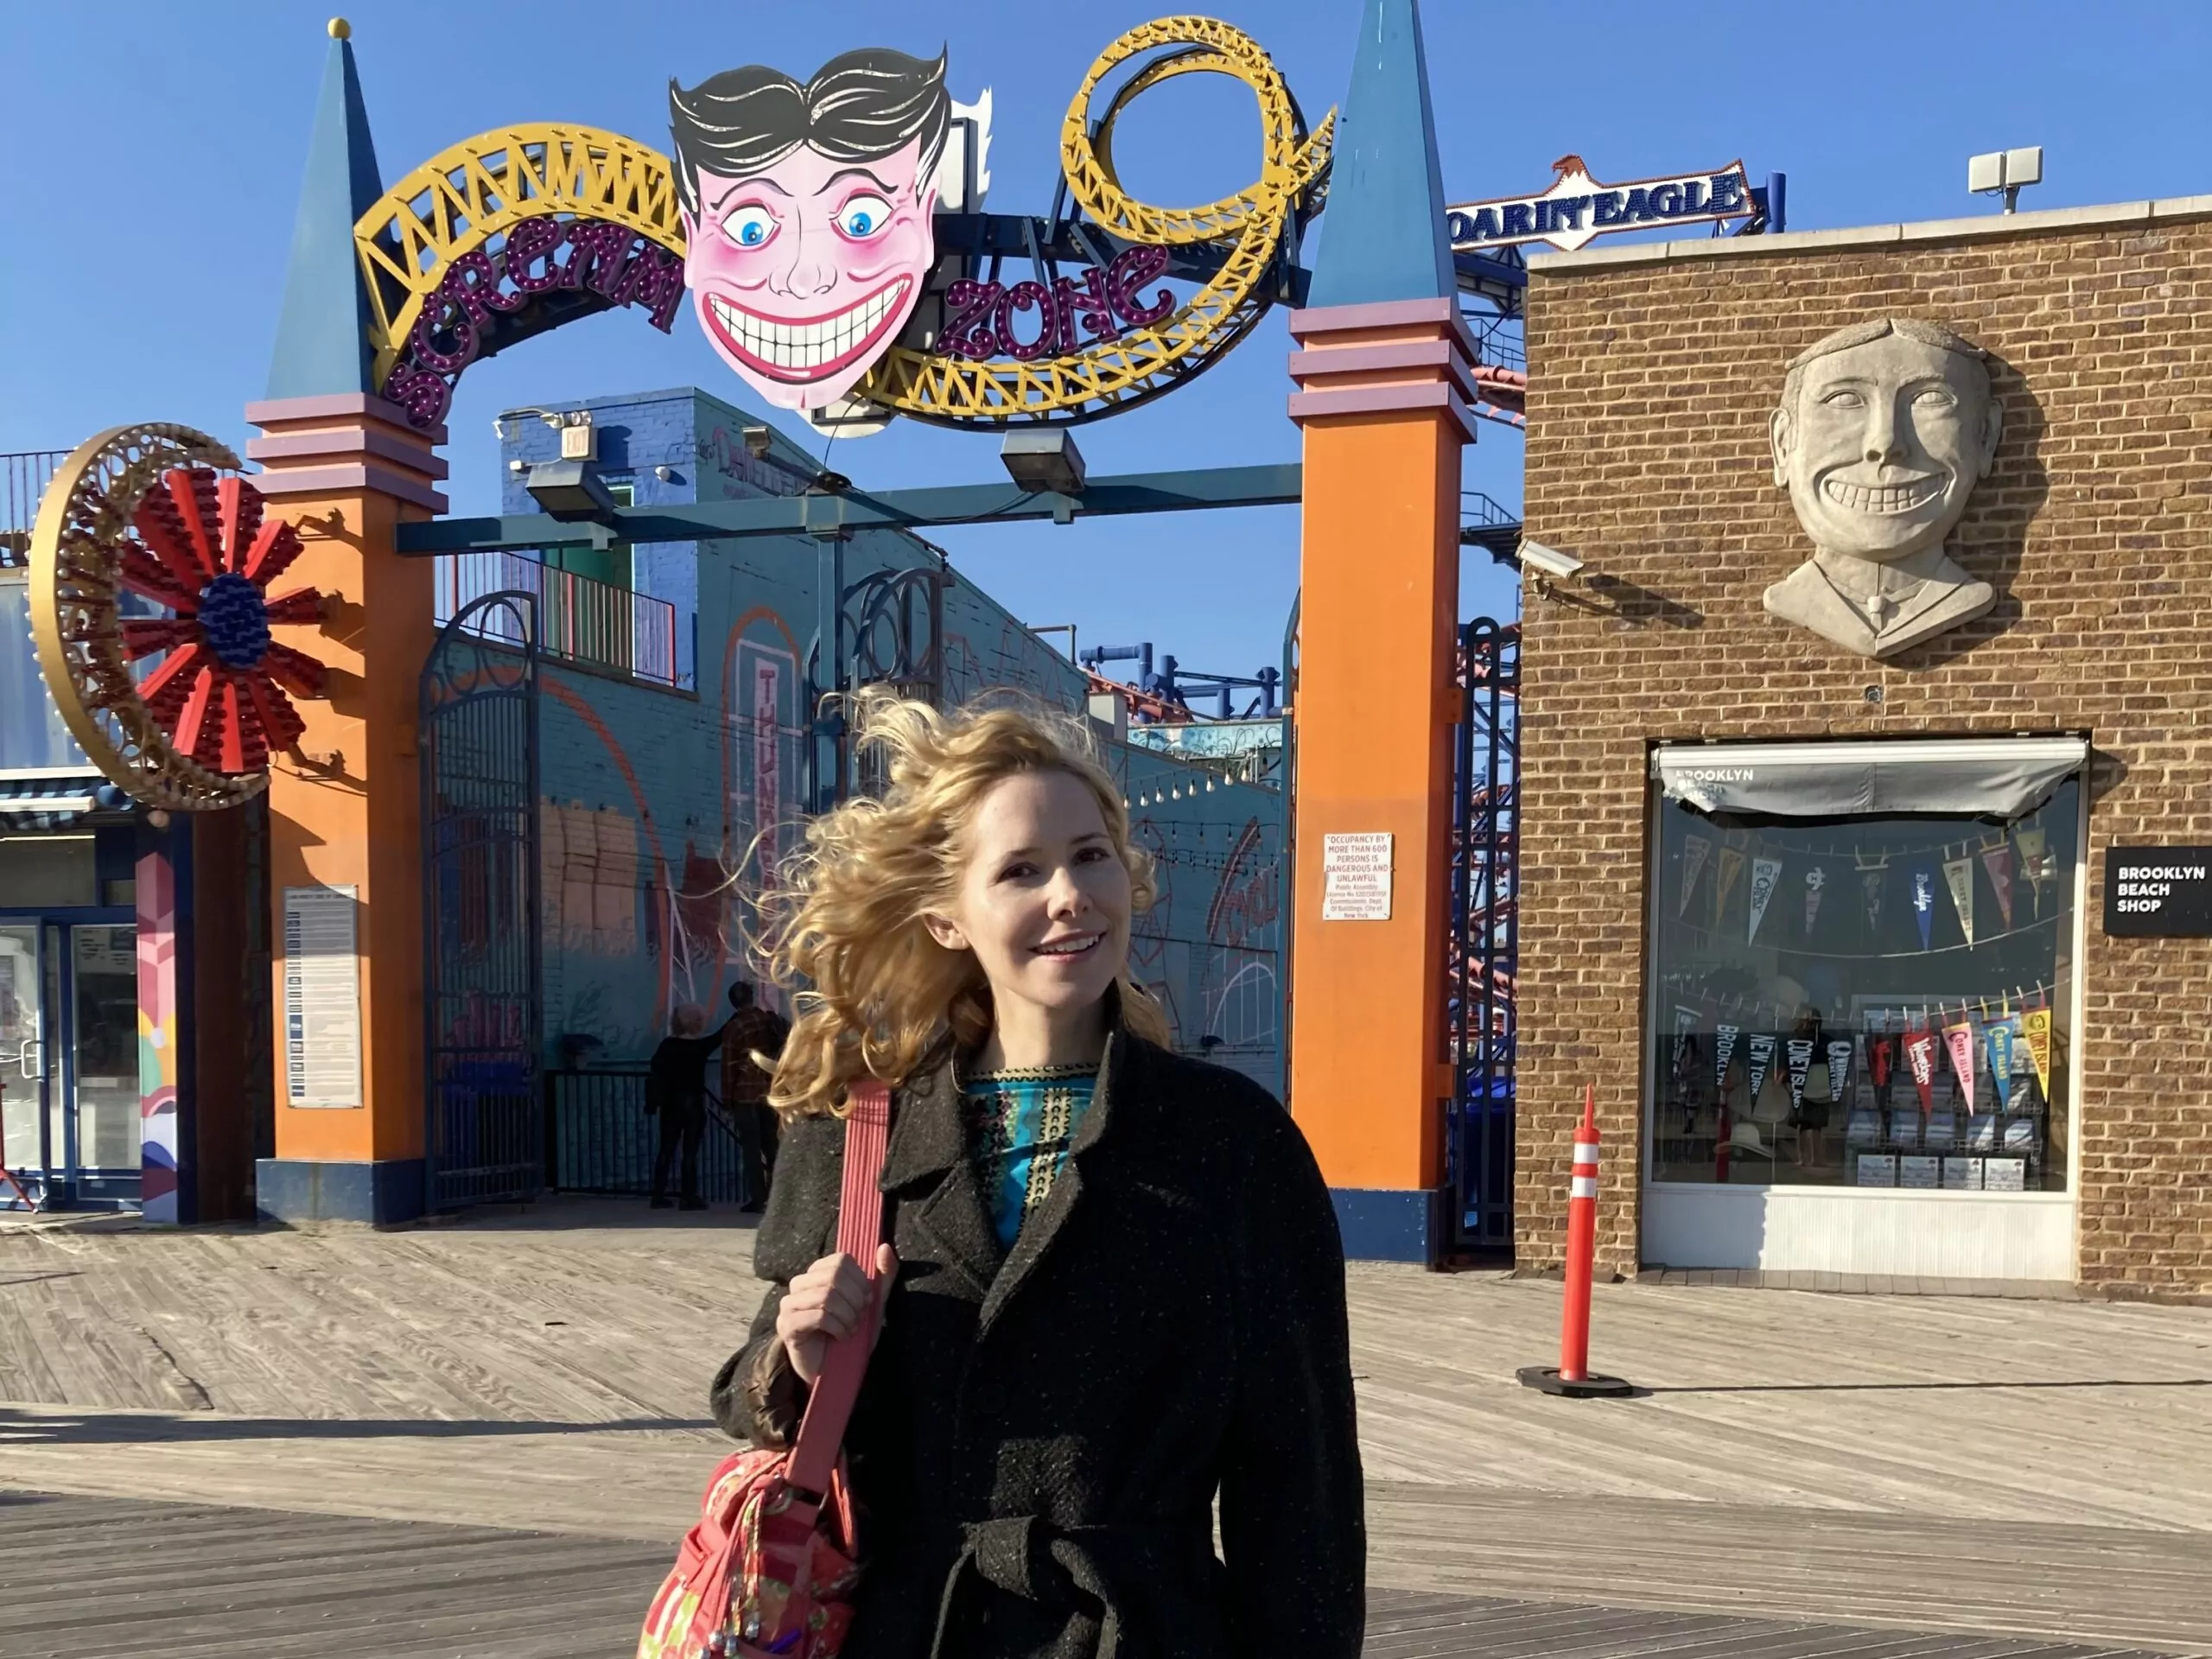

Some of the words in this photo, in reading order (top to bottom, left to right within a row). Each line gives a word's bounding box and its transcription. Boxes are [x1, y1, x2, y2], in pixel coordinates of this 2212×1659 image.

[1592, 171, 1745, 226] EAGLE
[934, 244, 1177, 361] ZONE
[1326, 864, 1371, 873] DANGEROUS
[1337, 855, 1370, 863] PERSONS
[2119, 867, 2206, 880] BROOKLYN
[2118, 883, 2171, 896] BEACH
[2117, 899, 2162, 912] SHOP
[1750, 1034, 1776, 1063] NEW
[1988, 1026, 2010, 1052] CONEY
[1717, 1025, 1738, 1086] BROOKLYN
[1787, 1039, 1814, 1072] CONEY
[1948, 1031, 1967, 1056] CONEY
[1959, 1058, 1971, 1083] ISLAND
[1750, 1065, 1767, 1096] YORK
[1790, 1074, 1807, 1109] ISLAND
